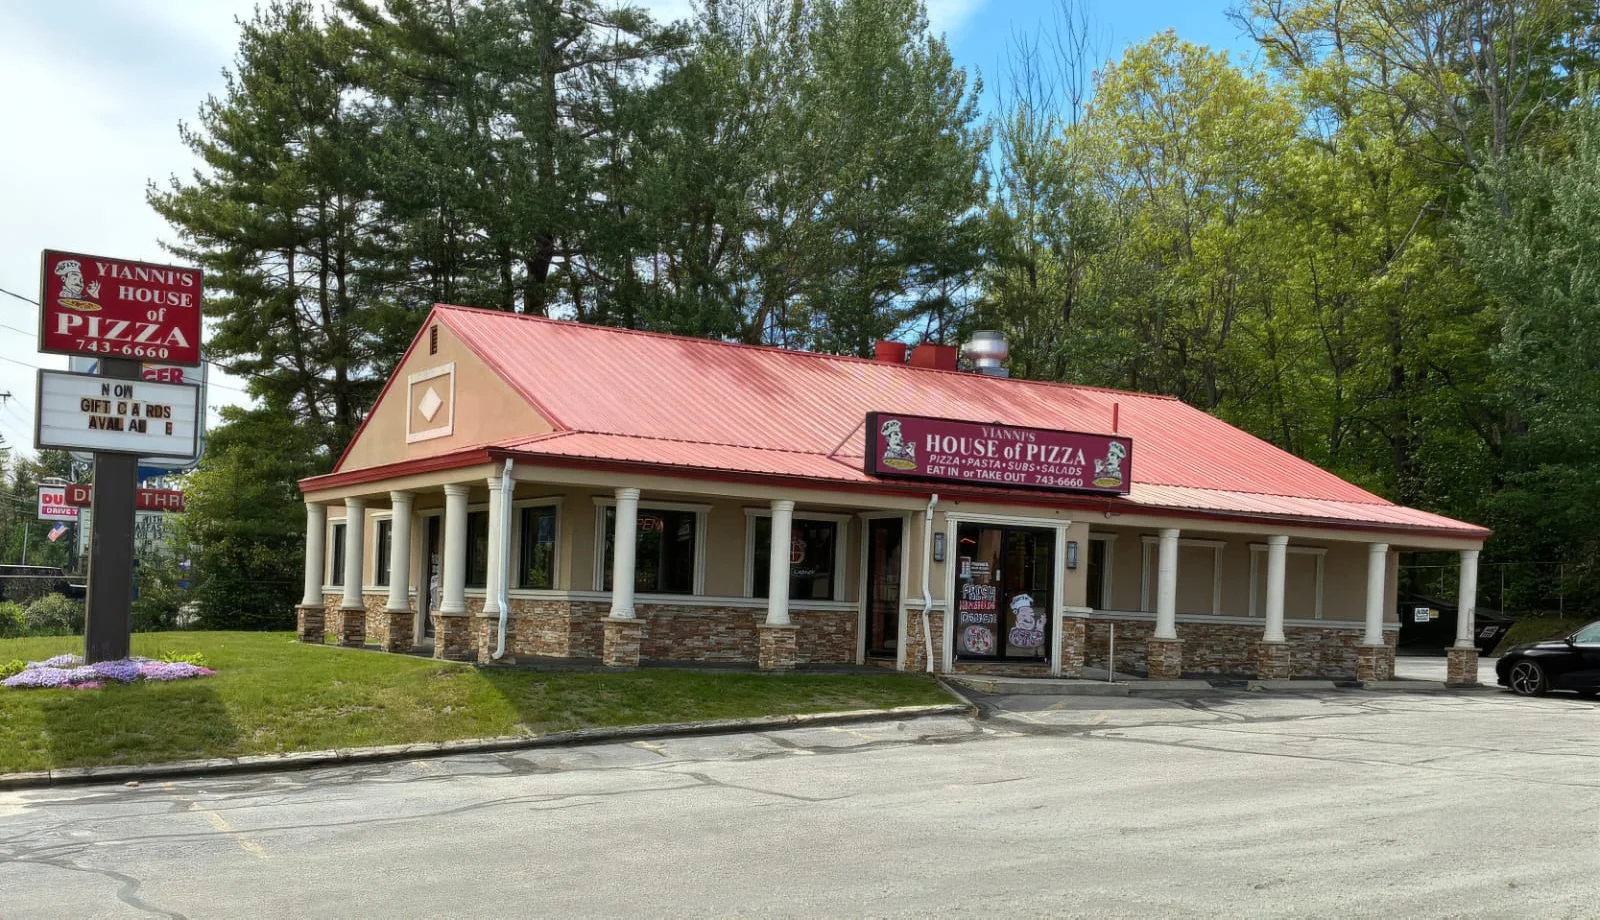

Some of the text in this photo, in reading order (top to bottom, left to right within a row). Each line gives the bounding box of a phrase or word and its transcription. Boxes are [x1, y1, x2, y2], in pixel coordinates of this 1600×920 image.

[95, 262, 193, 287] YIANNI'S
[118, 285, 193, 308] HOUSE
[147, 308, 166, 322] of
[53, 312, 190, 348] PIZZA
[76, 339, 169, 359] 743-6660
[101, 383, 133, 399] NOW
[80, 398, 111, 414] GIFT
[117, 401, 171, 419] CARDS
[982, 427, 1036, 442] YIANNI'S
[926, 433, 1086, 465] HOUSE of PIZZA
[929, 454, 1083, 476] PIZZA PASTA SUBS SALADS
[926, 464, 1084, 487] EAT IN or TAKE OUT 743-6660
[636, 518, 664, 531] PEN
